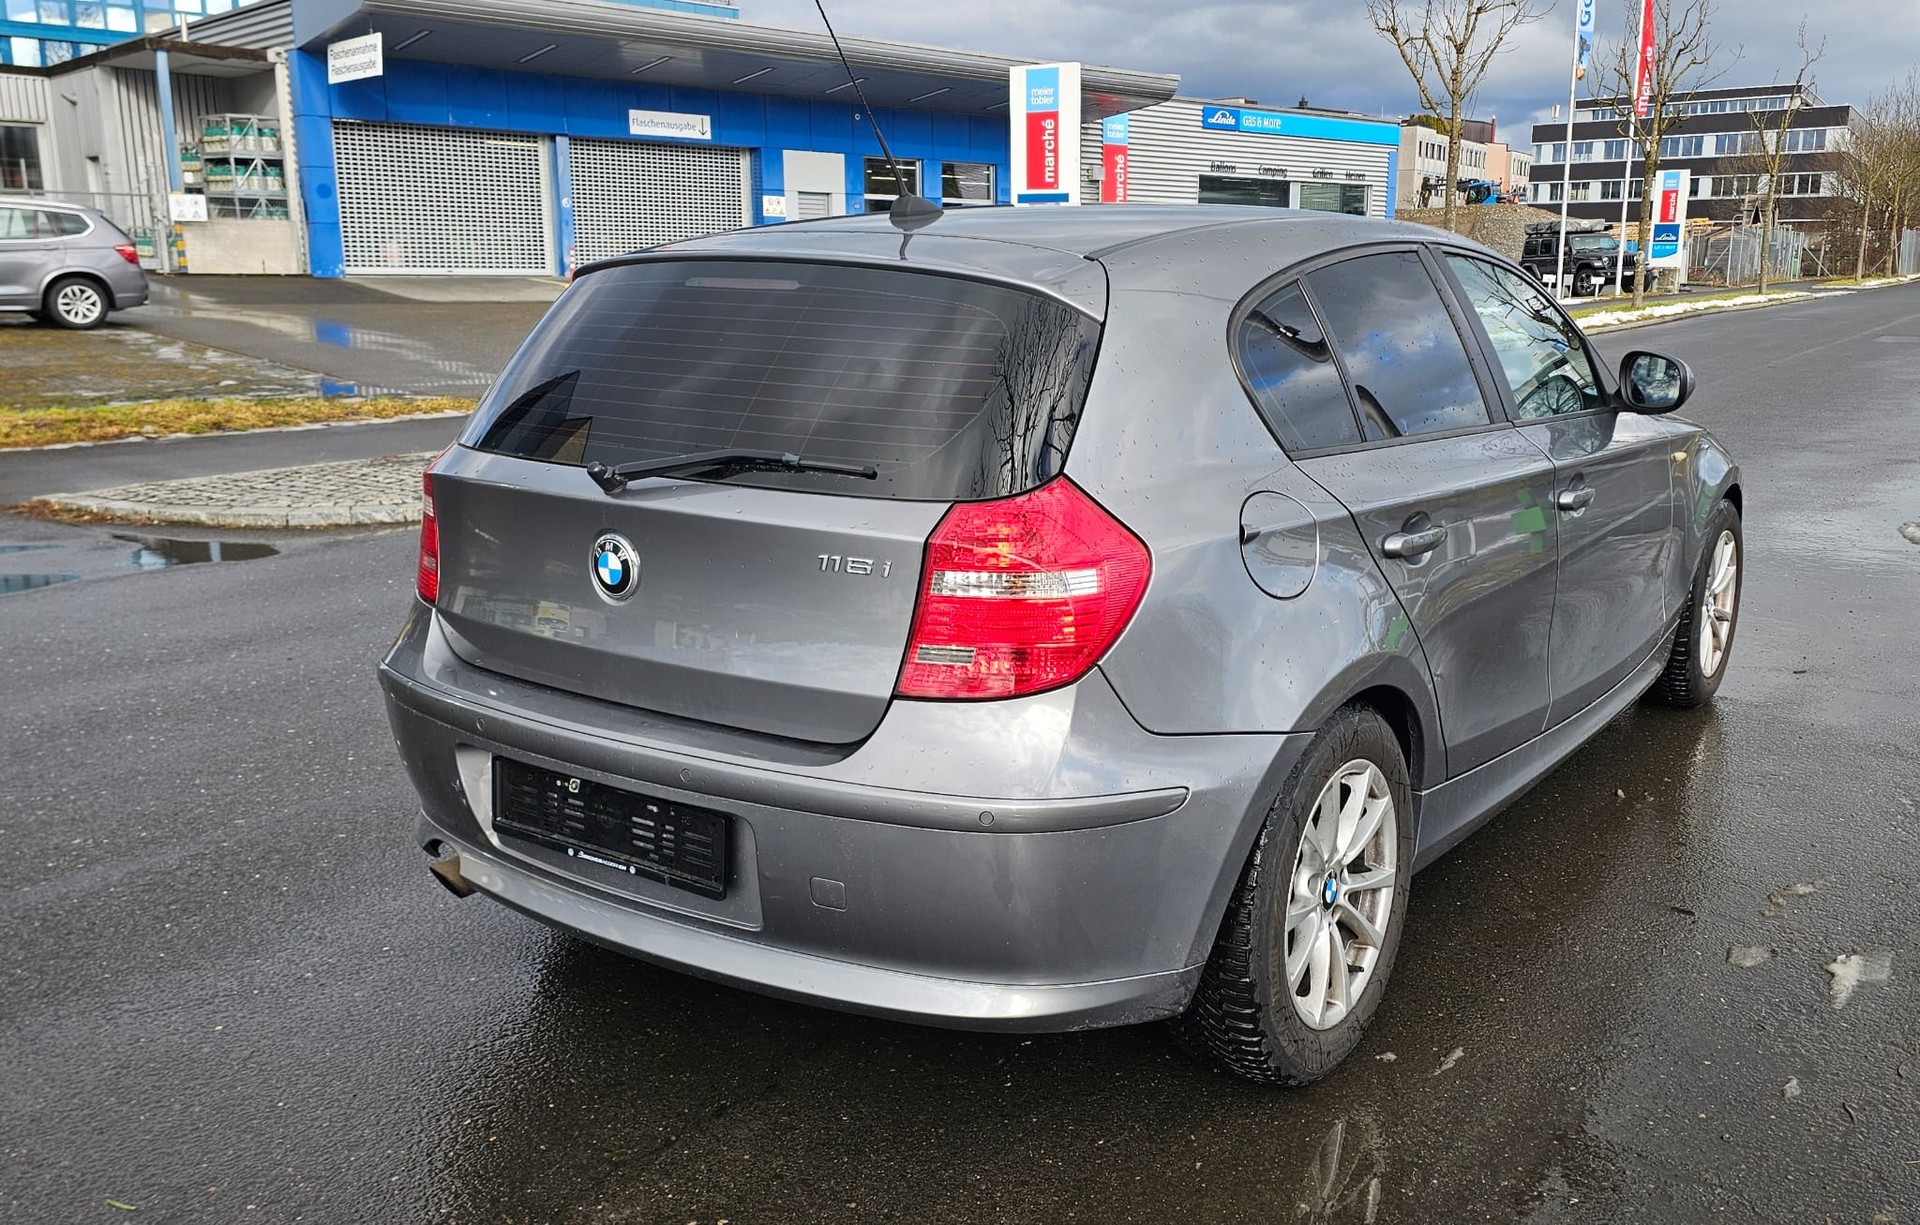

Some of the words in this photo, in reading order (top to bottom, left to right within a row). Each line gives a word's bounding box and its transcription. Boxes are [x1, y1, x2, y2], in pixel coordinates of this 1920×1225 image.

[1031, 86, 1054, 97] meier
[1031, 95, 1054, 105] tobler
[632, 118, 697, 132] Flaschenausgabe
[1207, 110, 1236, 126] Linde
[1042, 118, 1055, 183] marché
[595, 541, 629, 562] BMW
